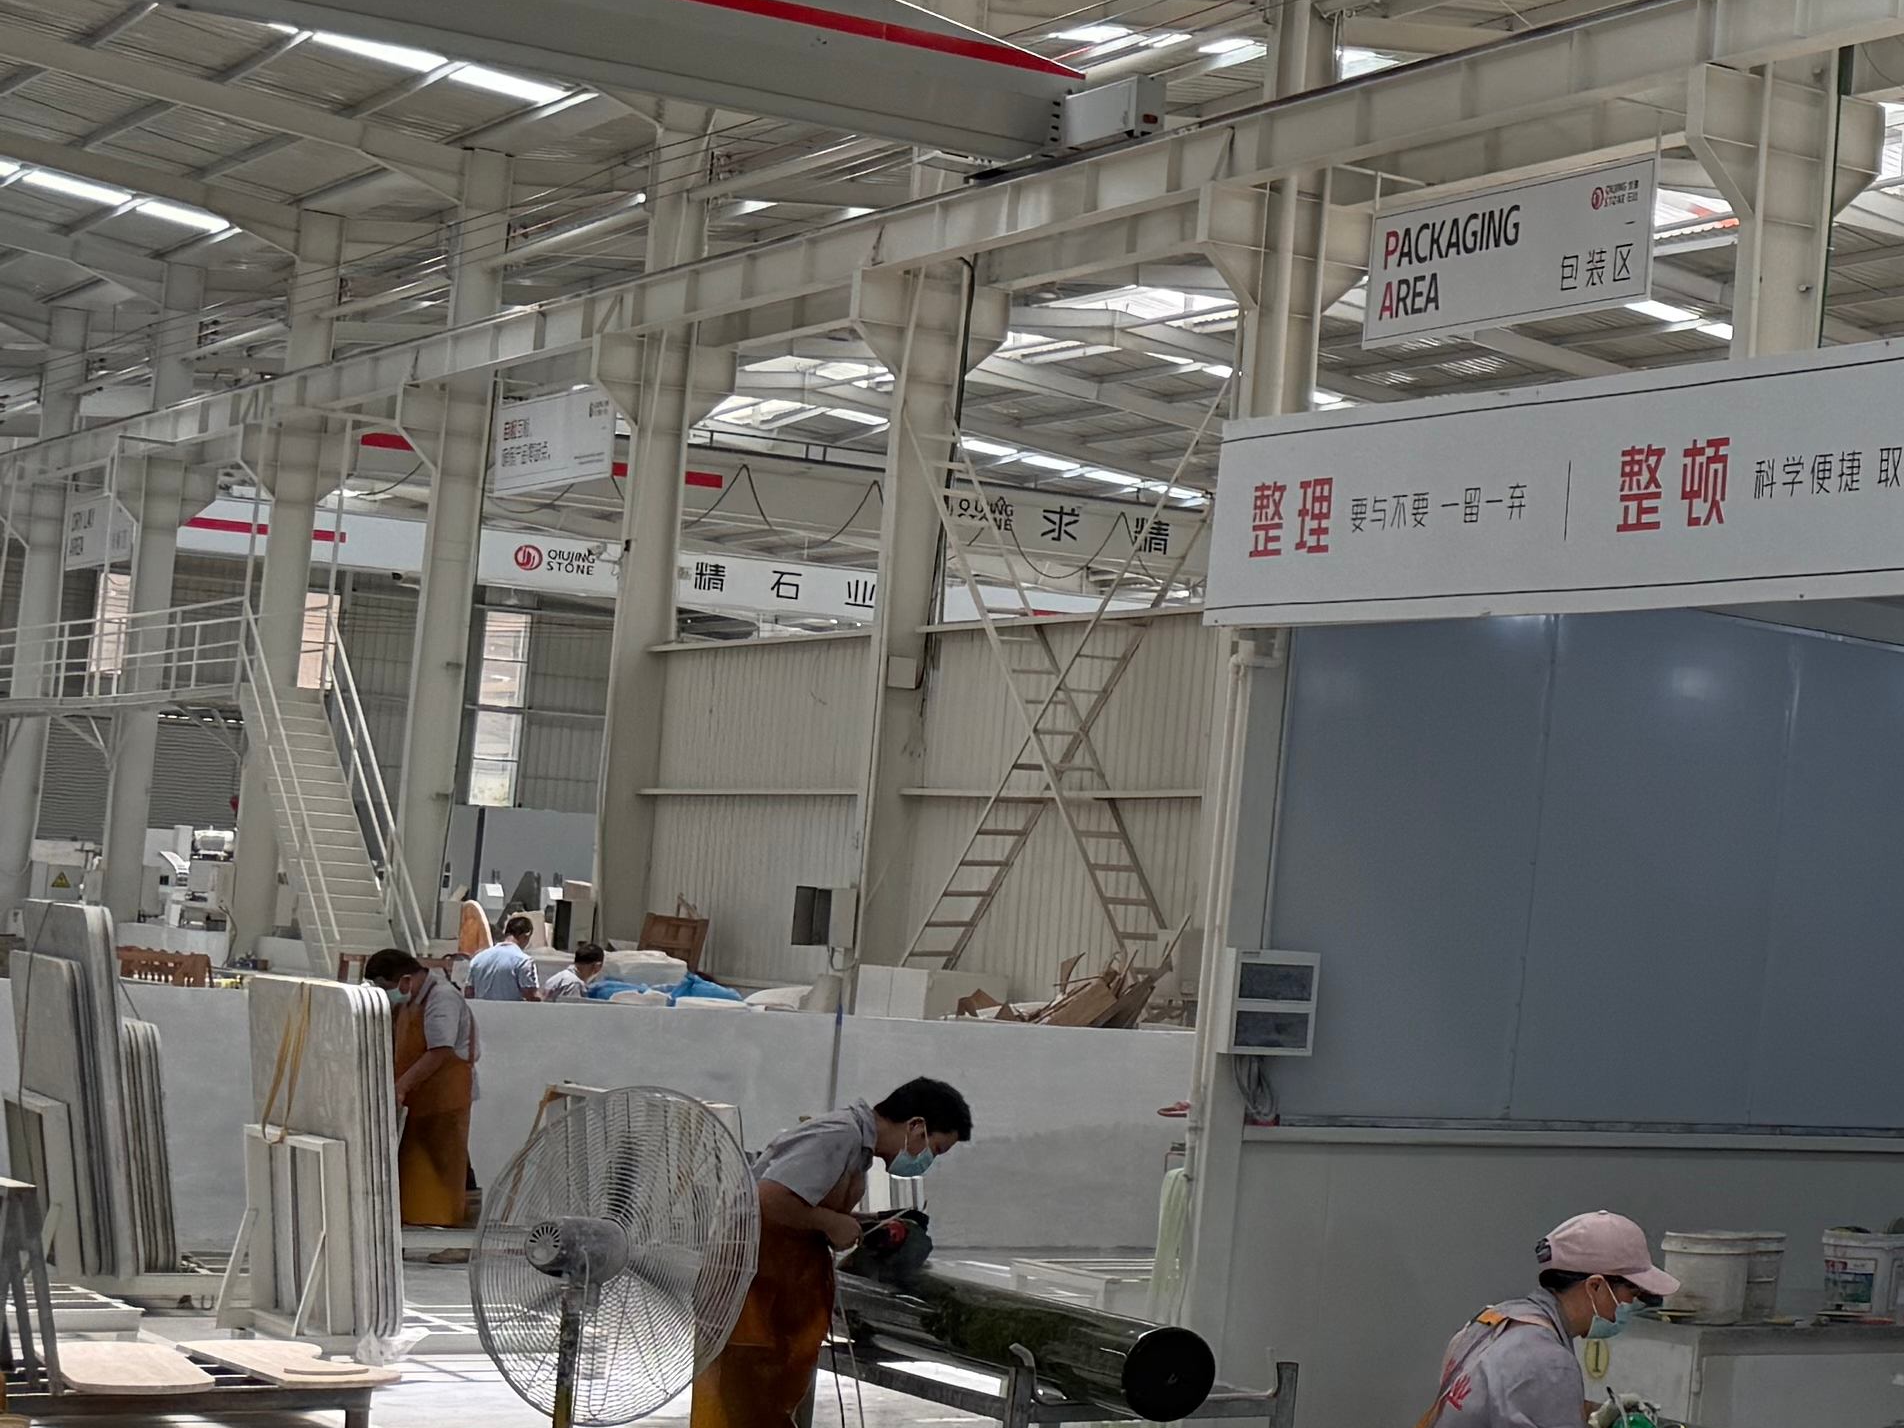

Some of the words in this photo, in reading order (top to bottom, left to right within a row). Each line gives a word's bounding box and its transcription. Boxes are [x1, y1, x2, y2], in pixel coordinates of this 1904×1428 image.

[1384, 204, 1521, 270] PACKAGING
[1560, 243, 1635, 291] 包装区
[1379, 272, 1440, 321] AREA
[1616, 437, 1730, 533] 整顿
[1754, 449, 1863, 501] 科学便捷
[1249, 477, 1334, 558] 整理
[1351, 492, 1430, 533] 要与不要
[1441, 483, 1527, 523] 一留一弃
[546, 561, 594, 575] STONE
